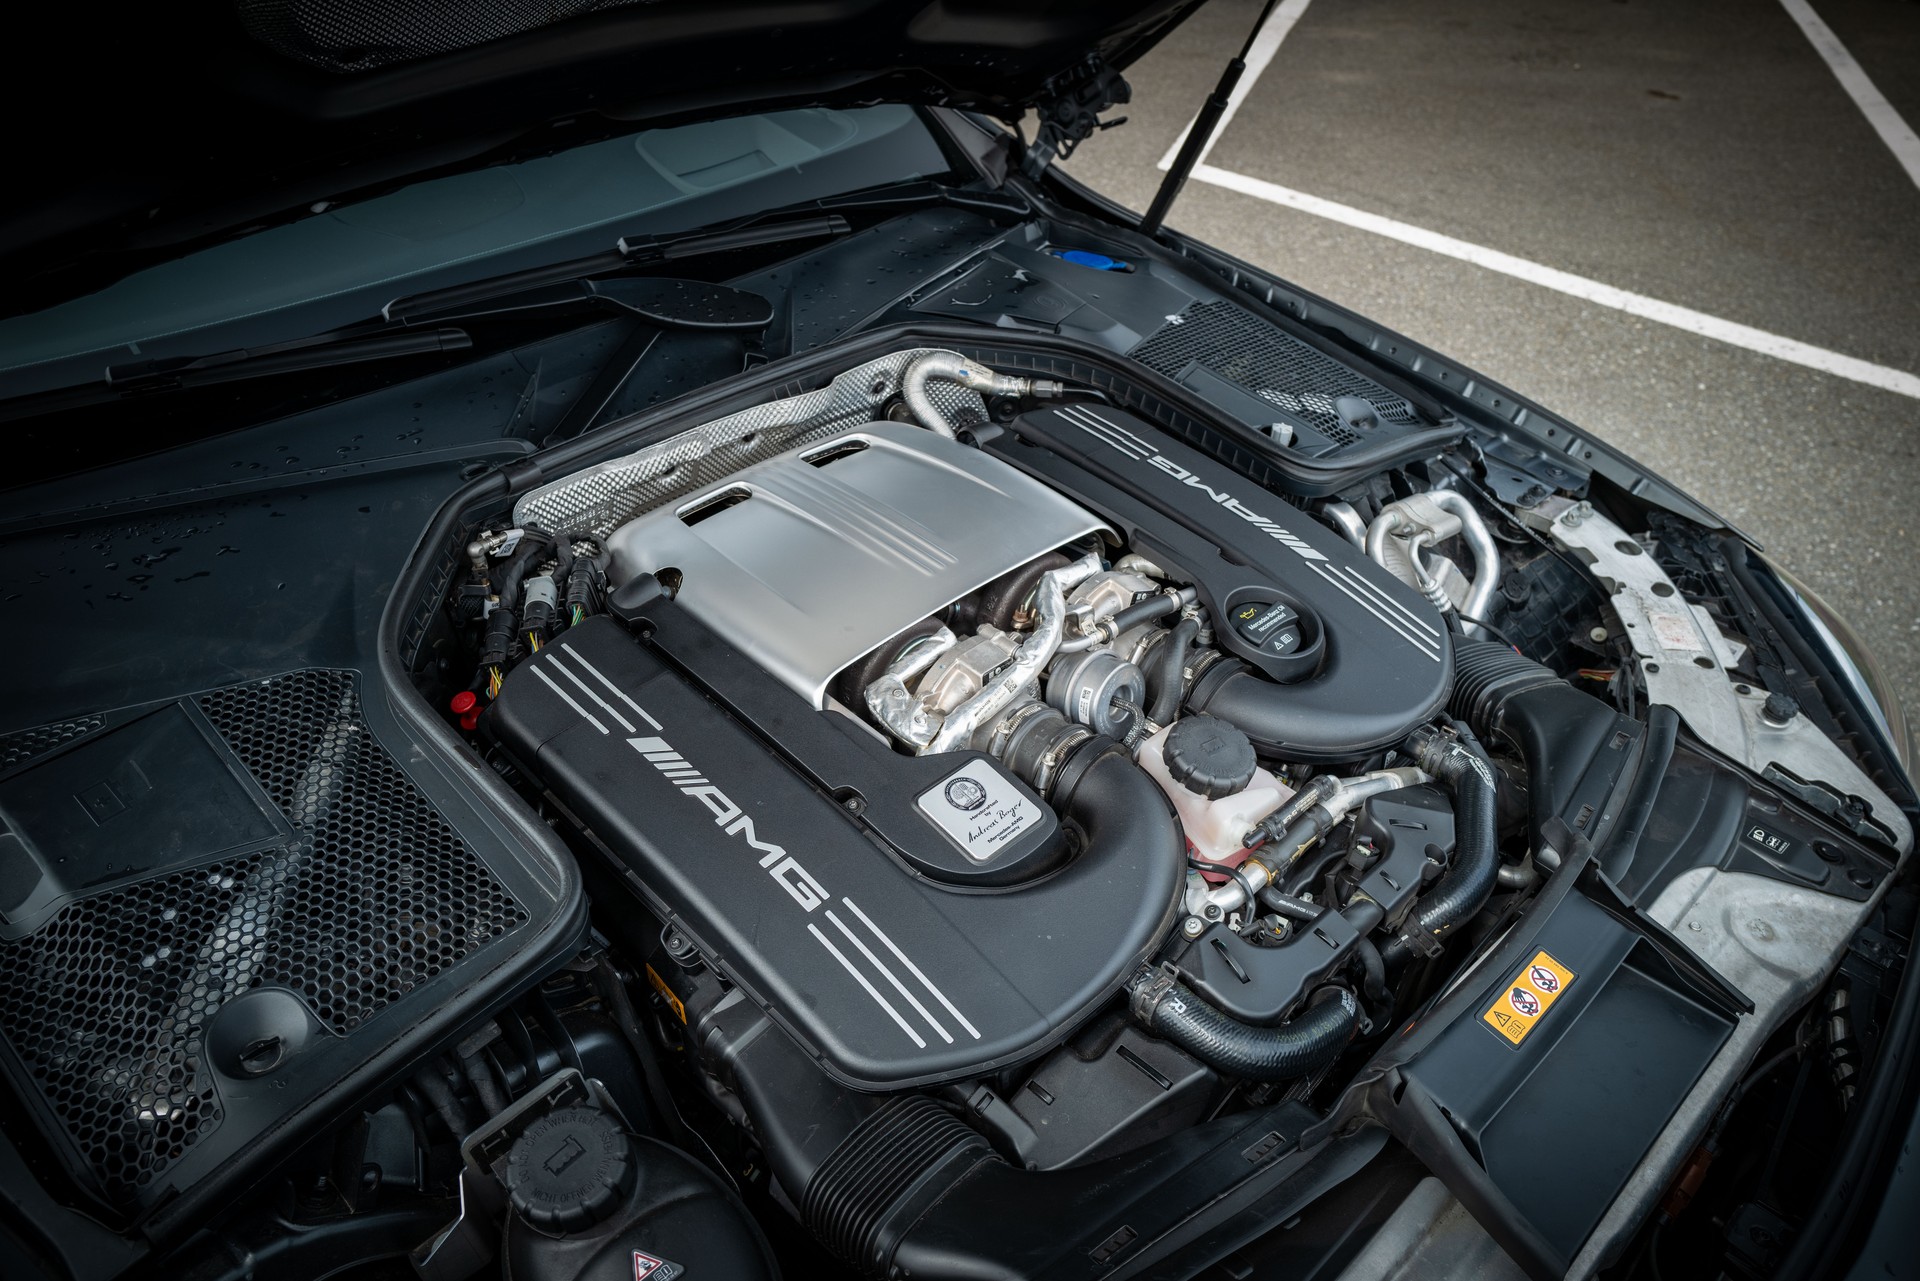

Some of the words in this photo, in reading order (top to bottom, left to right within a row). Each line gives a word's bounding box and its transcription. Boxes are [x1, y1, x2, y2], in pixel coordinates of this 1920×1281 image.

[1146, 455, 1273, 524] AMG
[1247, 609, 1280, 631] Mercedes-Benz
[1258, 611, 1287, 632] recommended
[969, 799, 999, 821] Handcrafted
[968, 819, 999, 843] Andreas
[987, 815, 1024, 843] Mercedes-AMG
[998, 825, 1021, 842] Germany
[680, 785, 831, 913] AMG
[526, 1124, 548, 1147] OPEN
[547, 1113, 577, 1129] WHEN
[530, 1187, 559, 1203] NICHT
[592, 1157, 612, 1184] WENN
